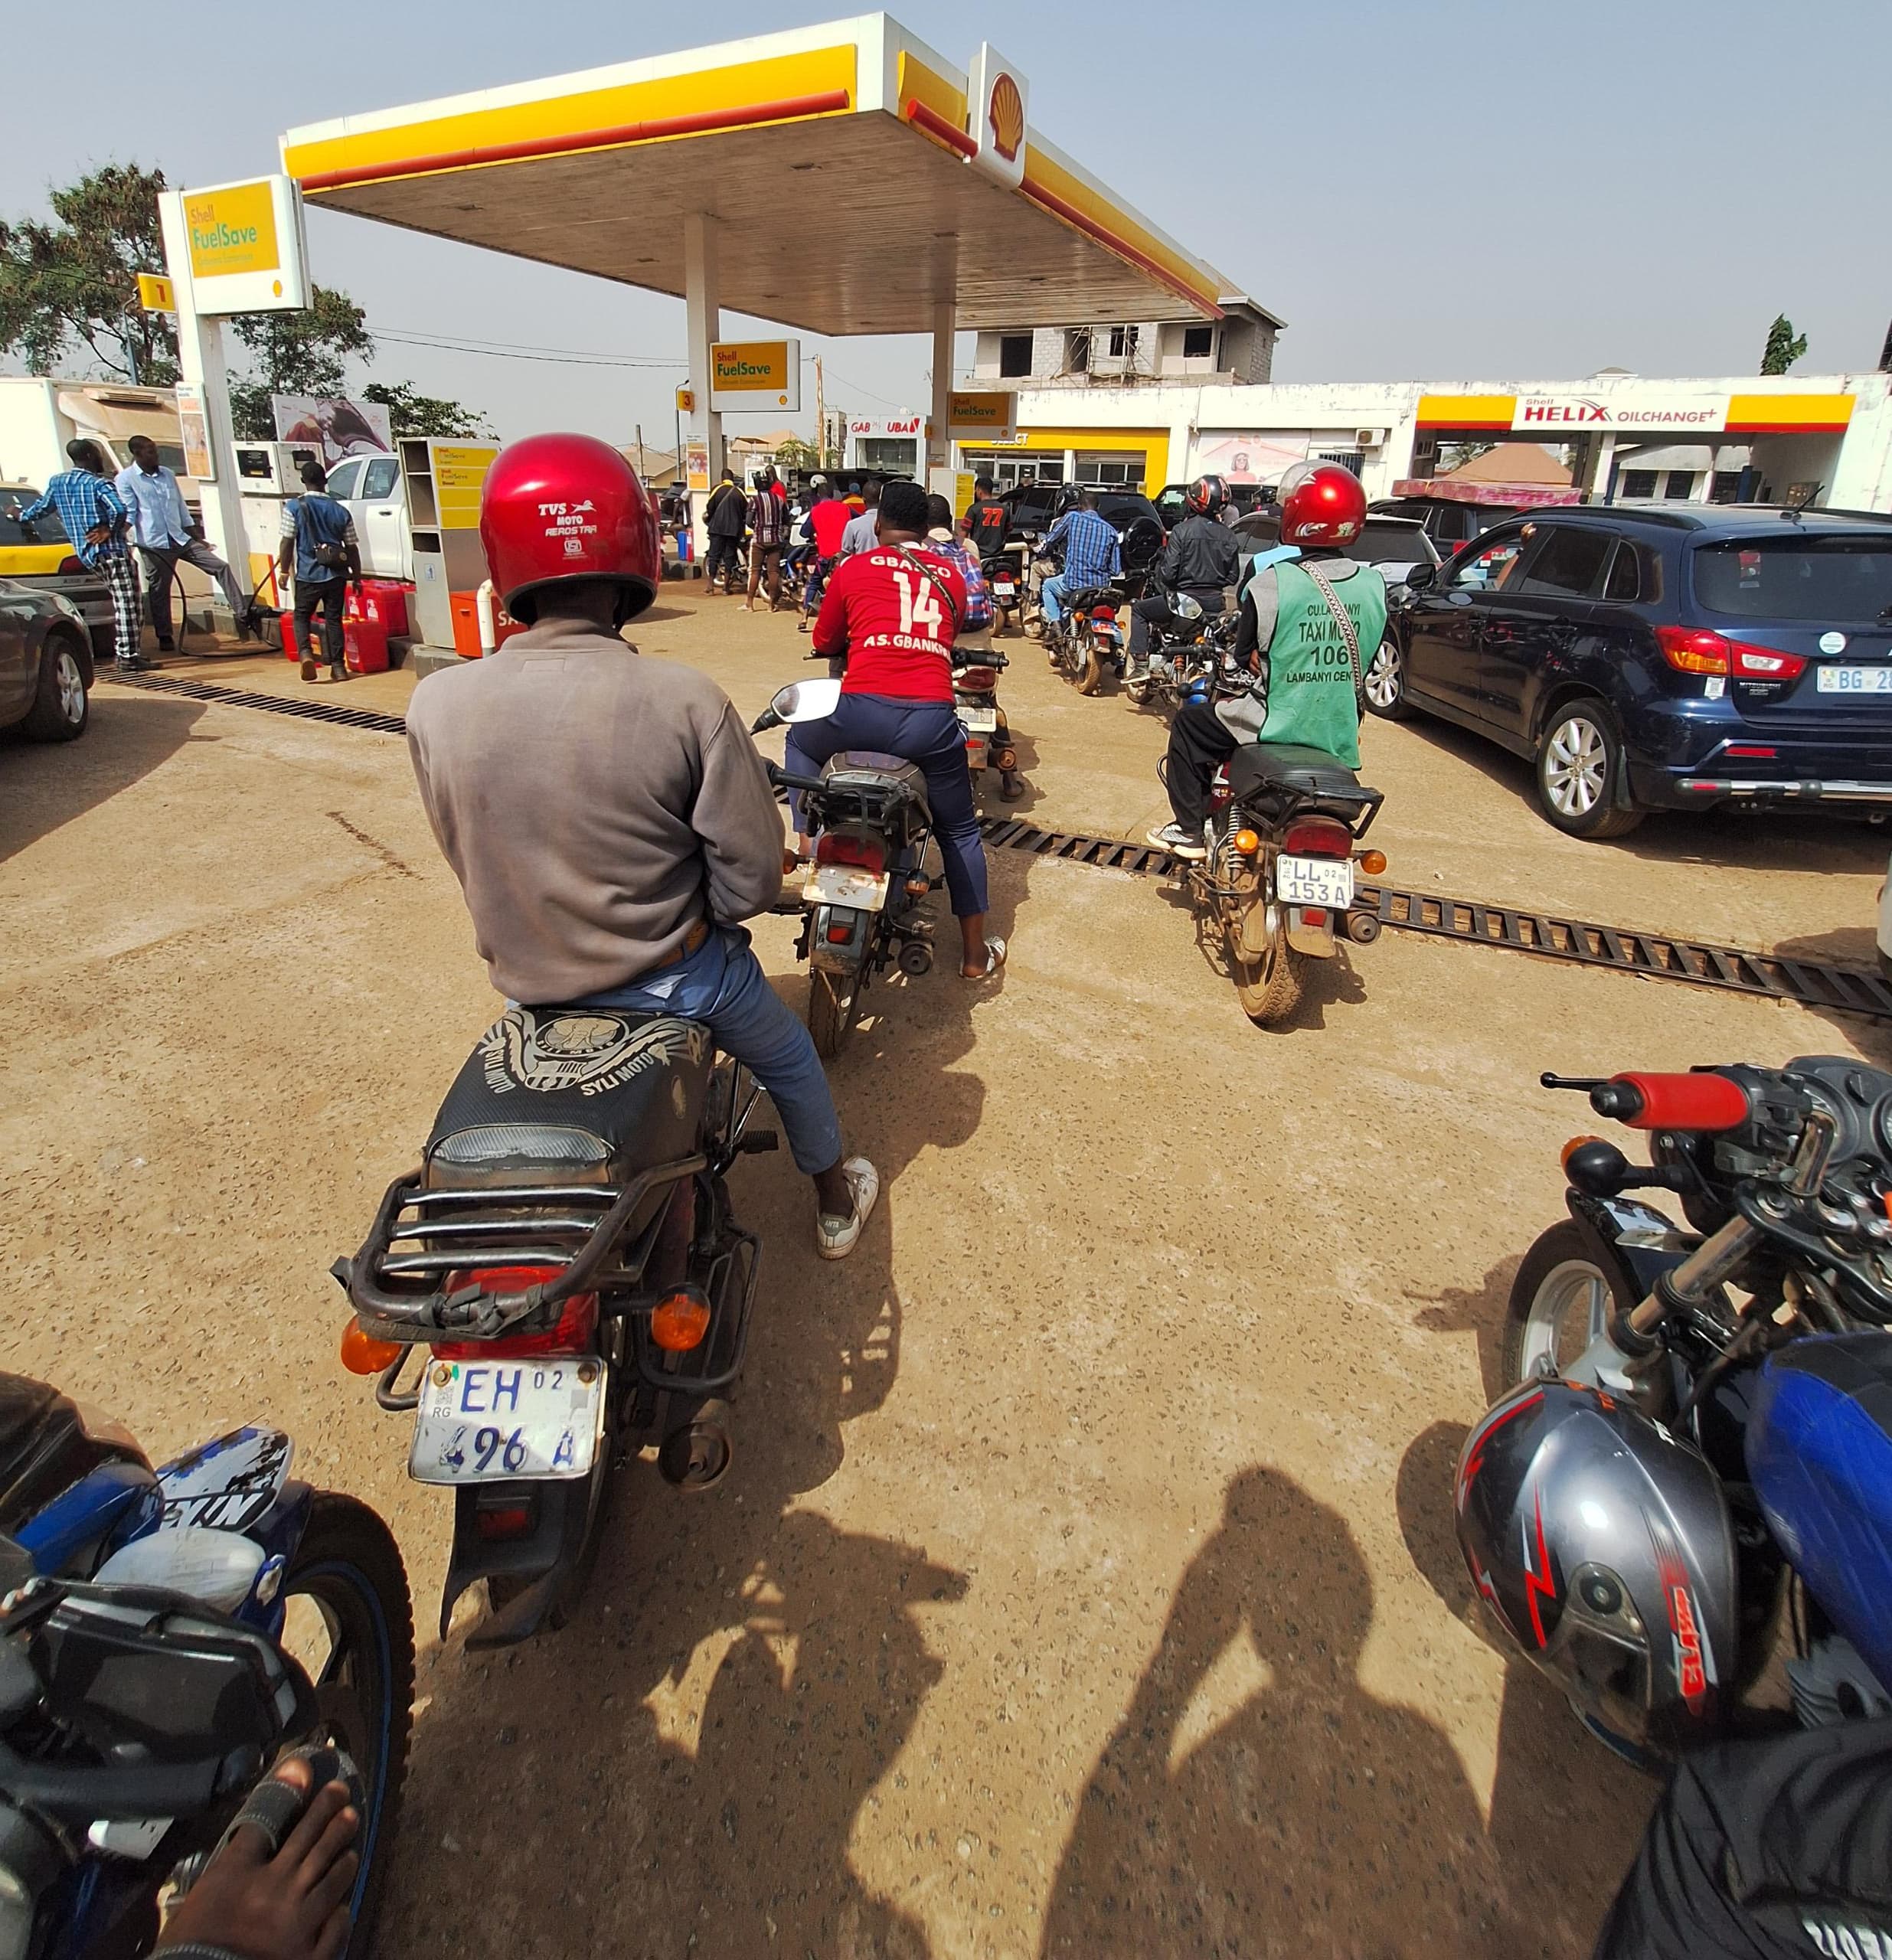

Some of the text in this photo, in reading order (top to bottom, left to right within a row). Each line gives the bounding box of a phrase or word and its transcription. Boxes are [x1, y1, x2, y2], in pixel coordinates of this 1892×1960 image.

[190, 204, 215, 224] Shell
[193, 222, 257, 250] FuelSave
[155, 283, 166, 302] 1
[717, 351, 737, 362] Shell
[717, 361, 771, 377] FuelSave
[684, 394, 691, 407] 3
[953, 397, 970, 406] Shell
[953, 406, 996, 416] FuelSave
[1524, 407, 1612, 422] HELIX
[851, 422, 871, 433] GAB
[887, 422, 909, 433] UBA
[538, 502, 567, 516] TVS
[982, 508, 1004, 527] 77
[557, 515, 583, 525] MOTO
[893, 571, 943, 639] 14
[1299, 621, 1325, 642] TAXI
[1310, 645, 1349, 666] 106
[1286, 672, 1332, 683] LAMBANYI
[1839, 670, 1862, 689] BG
[1294, 861, 1321, 882] LL
[1289, 881, 1346, 906] 153 A
[485, 1049, 517, 1094] SYLI MOTO
[580, 1051, 655, 1096] SYLI MOTO
[459, 1367, 522, 1413] EH
[432, 1406, 451, 1418] RG
[439, 1426, 574, 1473] 496 A
